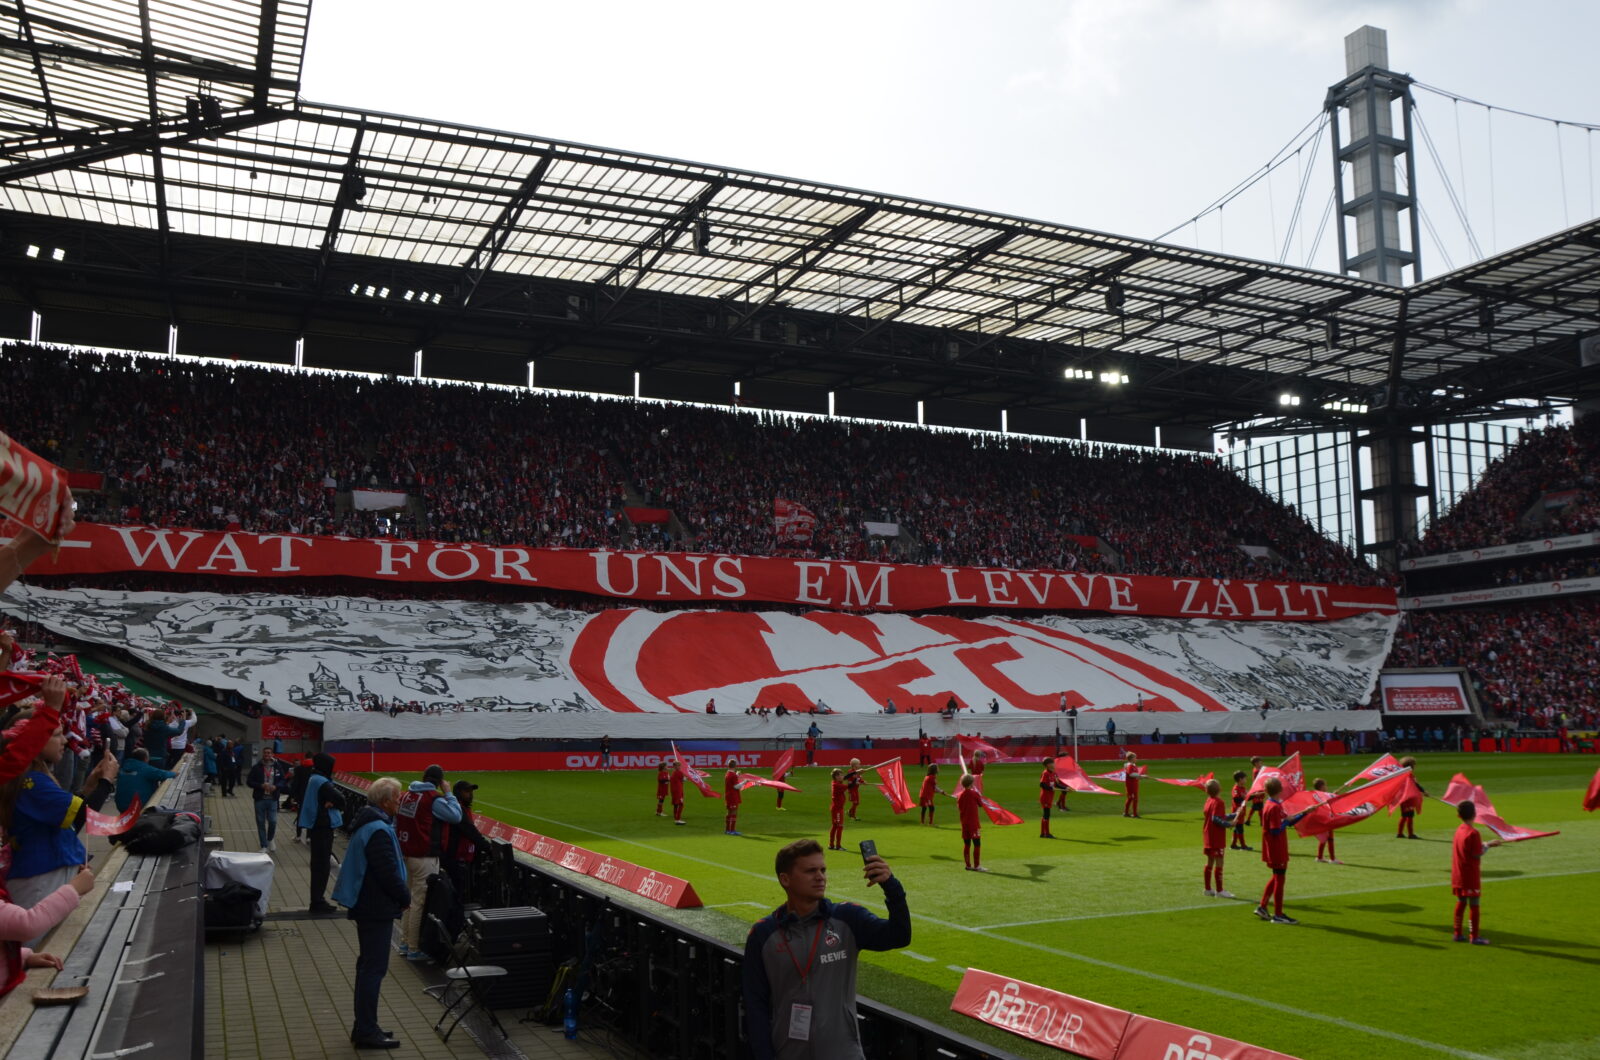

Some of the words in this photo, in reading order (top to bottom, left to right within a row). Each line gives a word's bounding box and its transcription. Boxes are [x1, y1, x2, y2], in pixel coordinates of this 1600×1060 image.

[110, 526, 312, 573] WAT
[374, 539, 538, 583] FÖR
[588, 550, 747, 597] UNS
[793, 560, 896, 607] EM
[940, 566, 1139, 612] LEVVE
[1172, 578, 1329, 618] ZÄLLT
[565, 755, 600, 768] OV
[724, 754, 761, 766] ALT
[820, 950, 848, 964] REWE
[980, 983, 1083, 1048] DERTOUR
